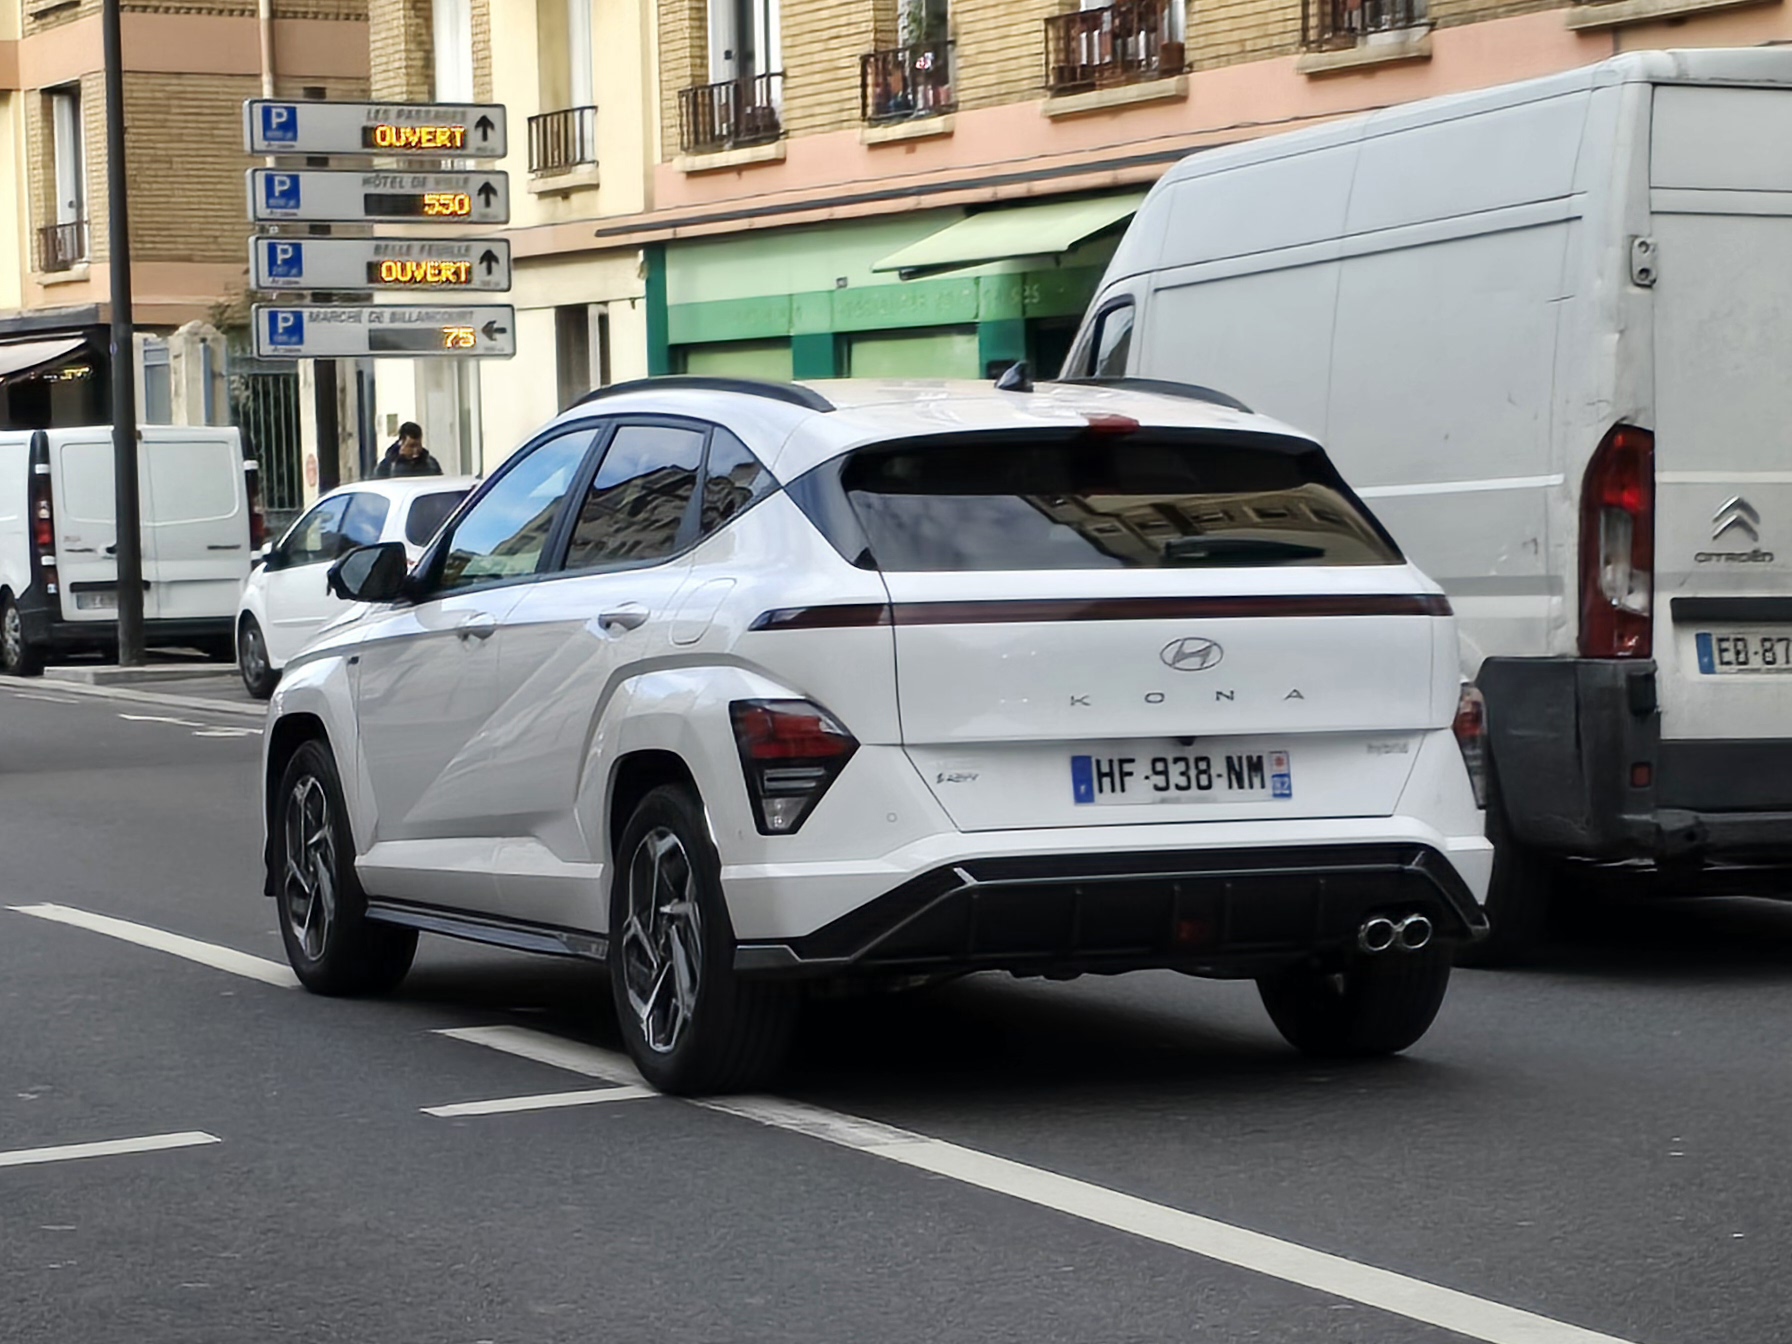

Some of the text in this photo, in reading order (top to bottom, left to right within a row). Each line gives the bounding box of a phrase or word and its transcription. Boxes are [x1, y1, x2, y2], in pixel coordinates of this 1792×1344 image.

[271, 107, 288, 129] P
[374, 125, 466, 148] OUVERT
[274, 175, 291, 197] P
[423, 193, 472, 216] 550
[276, 244, 293, 266] P
[380, 260, 471, 284] OUVERT
[277, 312, 294, 333] P
[442, 326, 477, 348] 75
[1069, 687, 1306, 708] KONA
[1095, 754, 1267, 794] HF-938-NM
